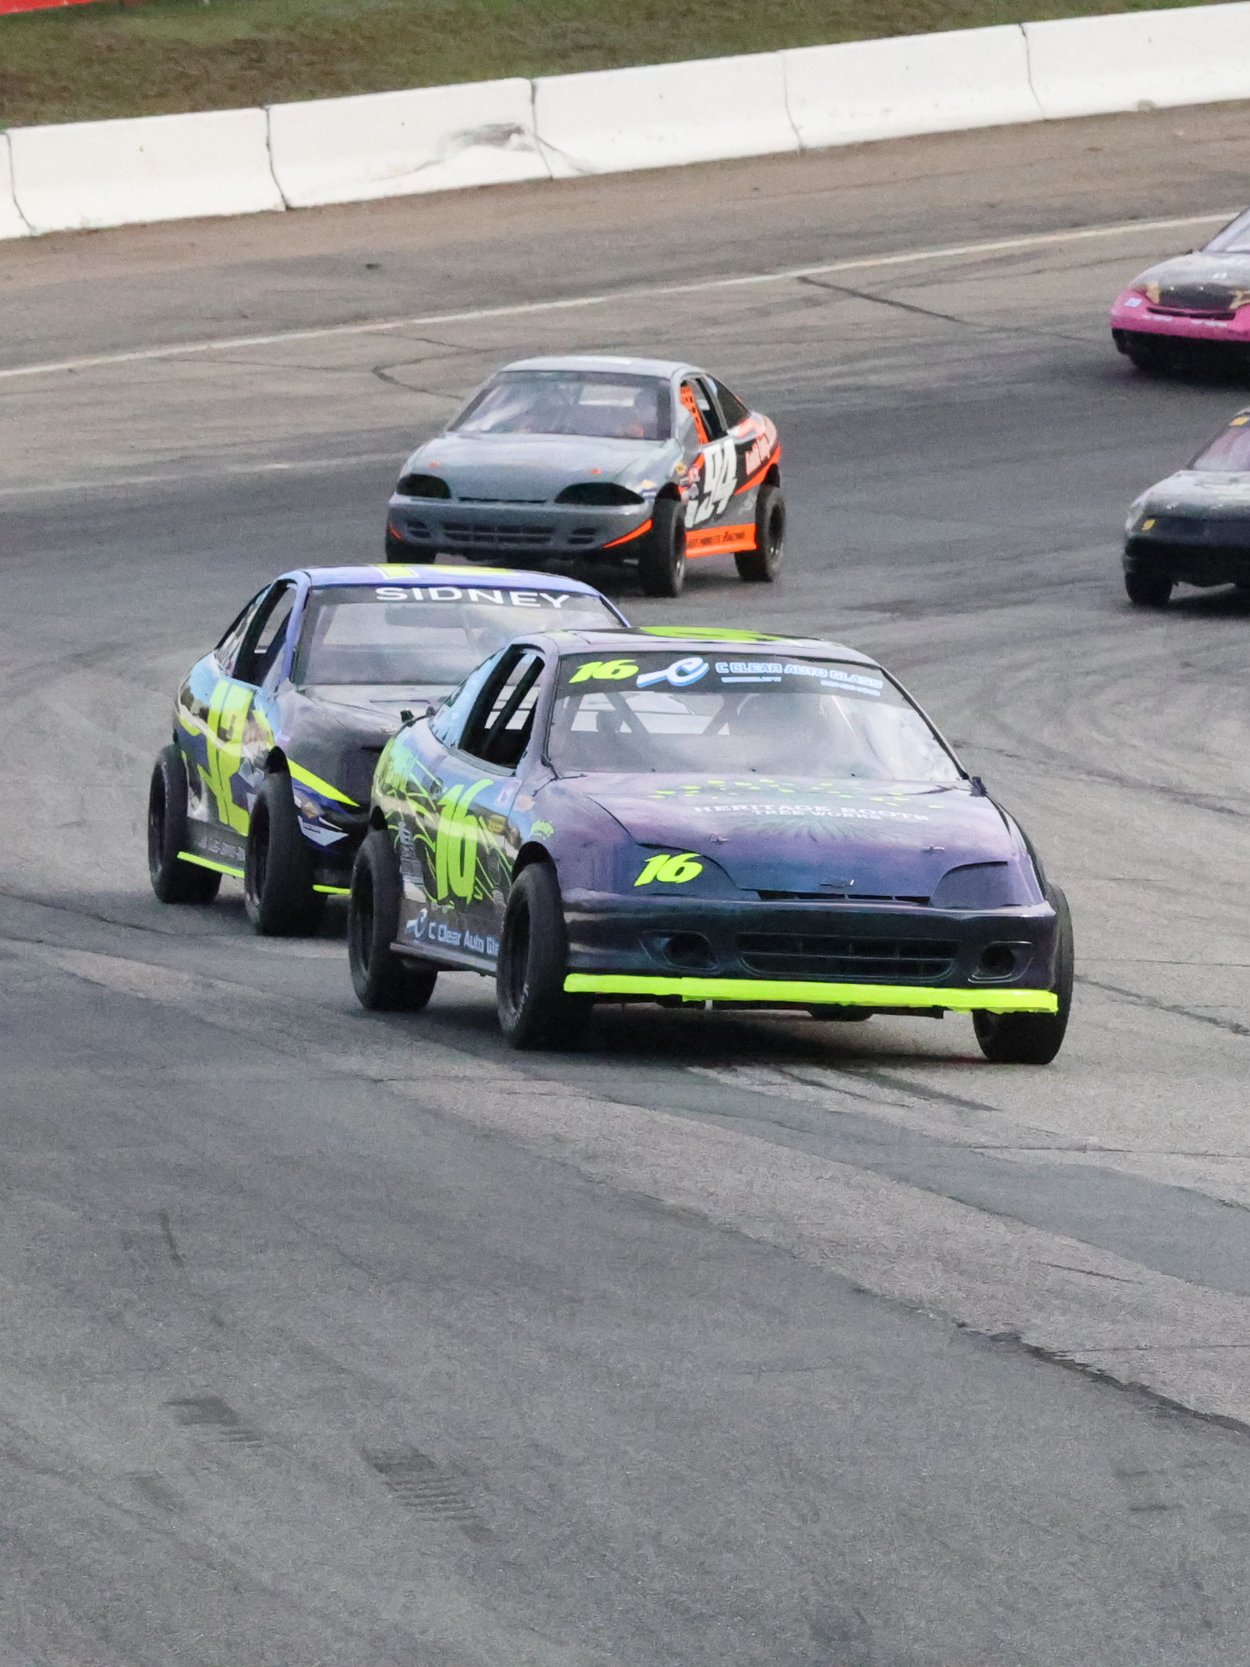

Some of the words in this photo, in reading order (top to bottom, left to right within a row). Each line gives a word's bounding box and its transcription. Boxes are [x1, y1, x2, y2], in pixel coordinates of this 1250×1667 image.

[376, 587, 569, 609] SIDNEY
[569, 659, 640, 683] 16
[731, 662, 783, 675] CLEAR
[784, 664, 828, 678] AUTO
[829, 670, 884, 689] GLASS
[694, 804, 832, 813] HERITAGE
[435, 779, 494, 905] 16
[634, 853, 704, 886] 16
[464, 930, 485, 953] Auto
